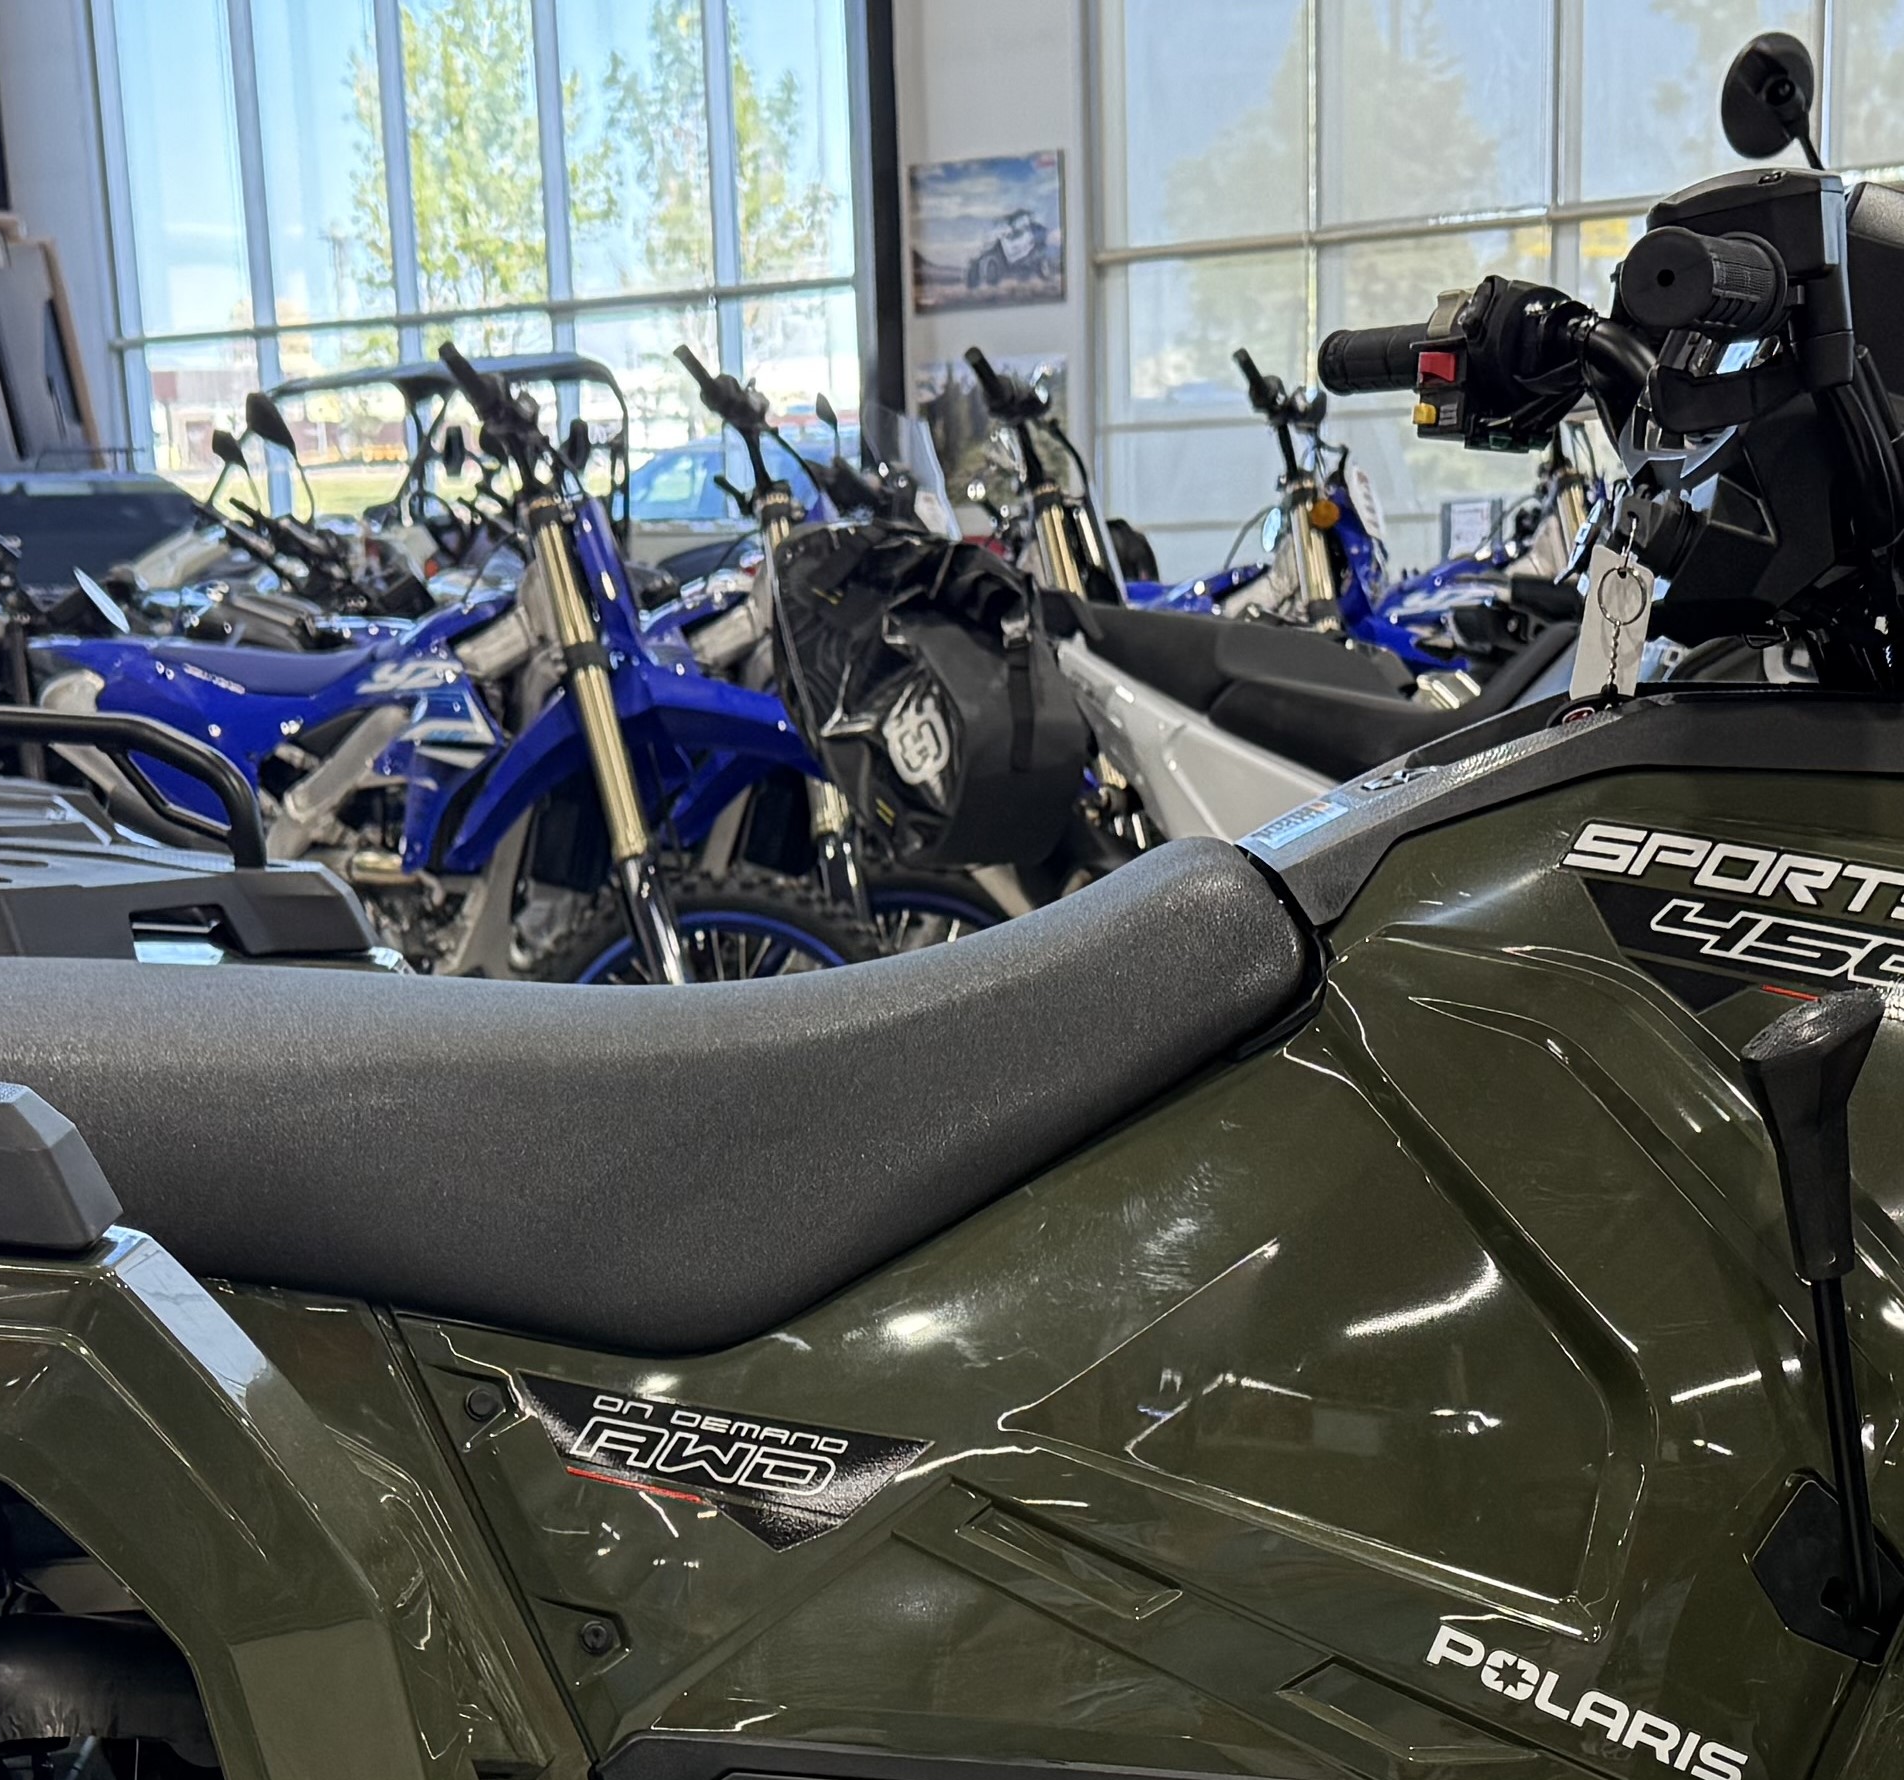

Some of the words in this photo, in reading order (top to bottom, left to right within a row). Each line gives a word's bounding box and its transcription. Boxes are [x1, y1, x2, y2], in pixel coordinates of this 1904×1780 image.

[570, 1415, 837, 1497] AWD
[592, 1394, 654, 1419] ON
[669, 1410, 848, 1454] DEMAND
